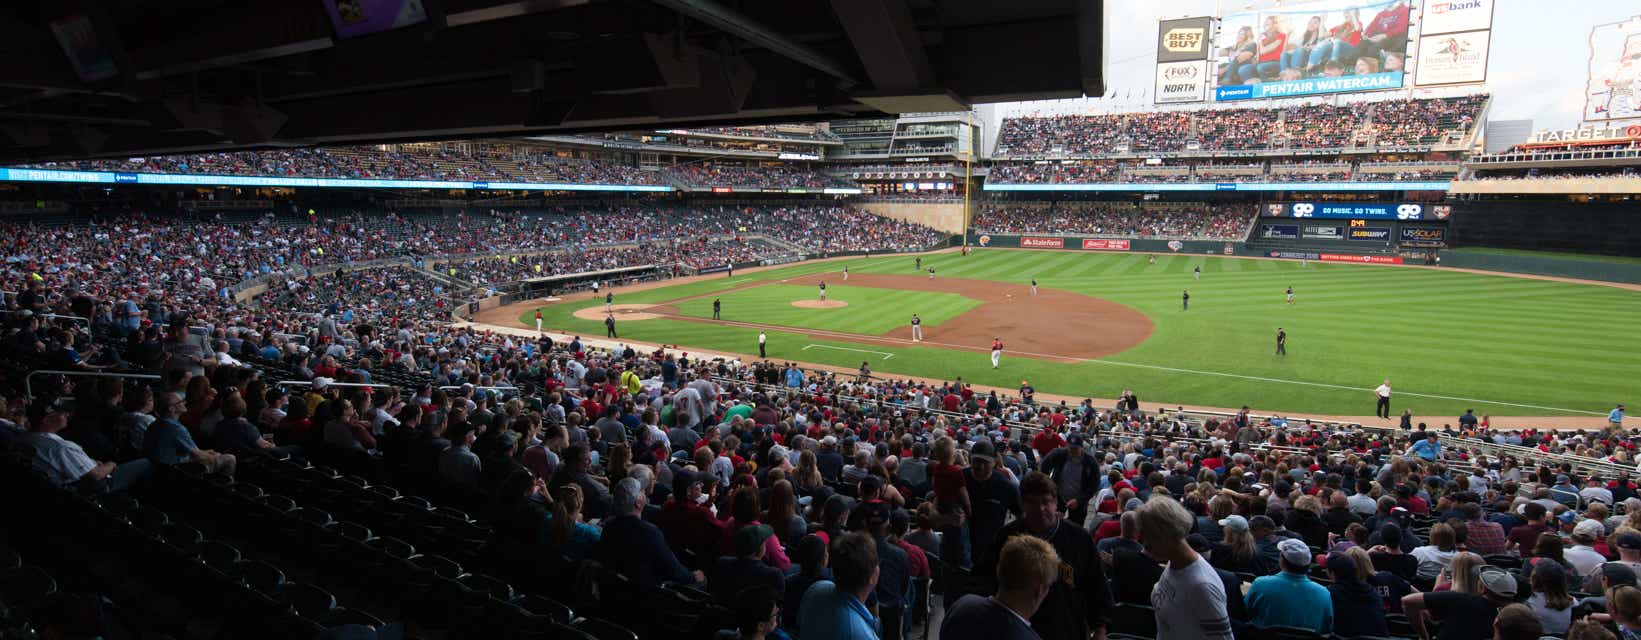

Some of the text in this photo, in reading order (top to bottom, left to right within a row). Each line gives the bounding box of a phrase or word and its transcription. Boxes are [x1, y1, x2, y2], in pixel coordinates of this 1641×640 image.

[1168, 32, 1202, 40] BEST
[1168, 40, 1199, 48] BUY
[1171, 66, 1191, 76] FOX
[1163, 83, 1196, 93] NORTH
[1262, 82, 1313, 96] PENTAIR
[1317, 75, 1390, 91] WATERCAM
[1536, 128, 1617, 142] TARGET
